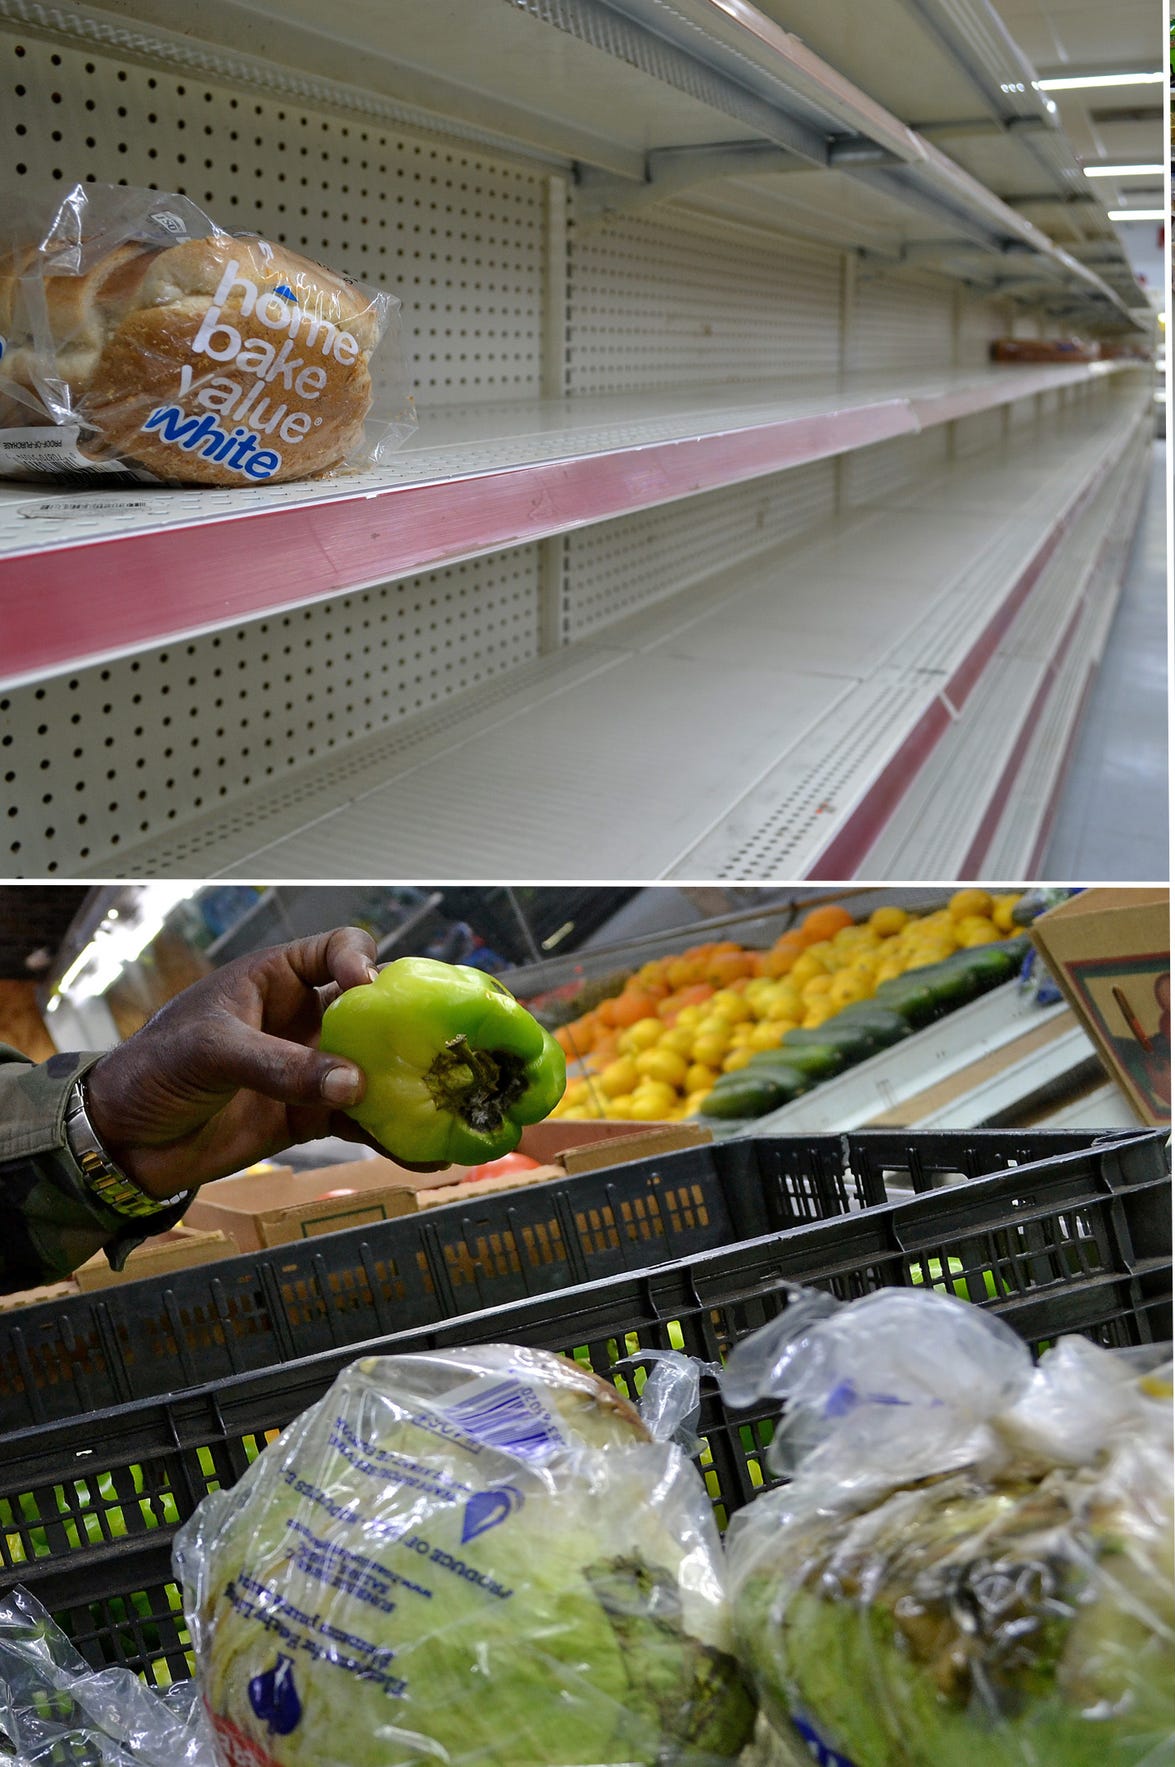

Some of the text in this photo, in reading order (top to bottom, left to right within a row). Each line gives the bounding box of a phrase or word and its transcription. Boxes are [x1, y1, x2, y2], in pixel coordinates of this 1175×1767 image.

[192, 306, 327, 400] bake
[214, 260, 359, 367] home
[143, 404, 283, 482] white
